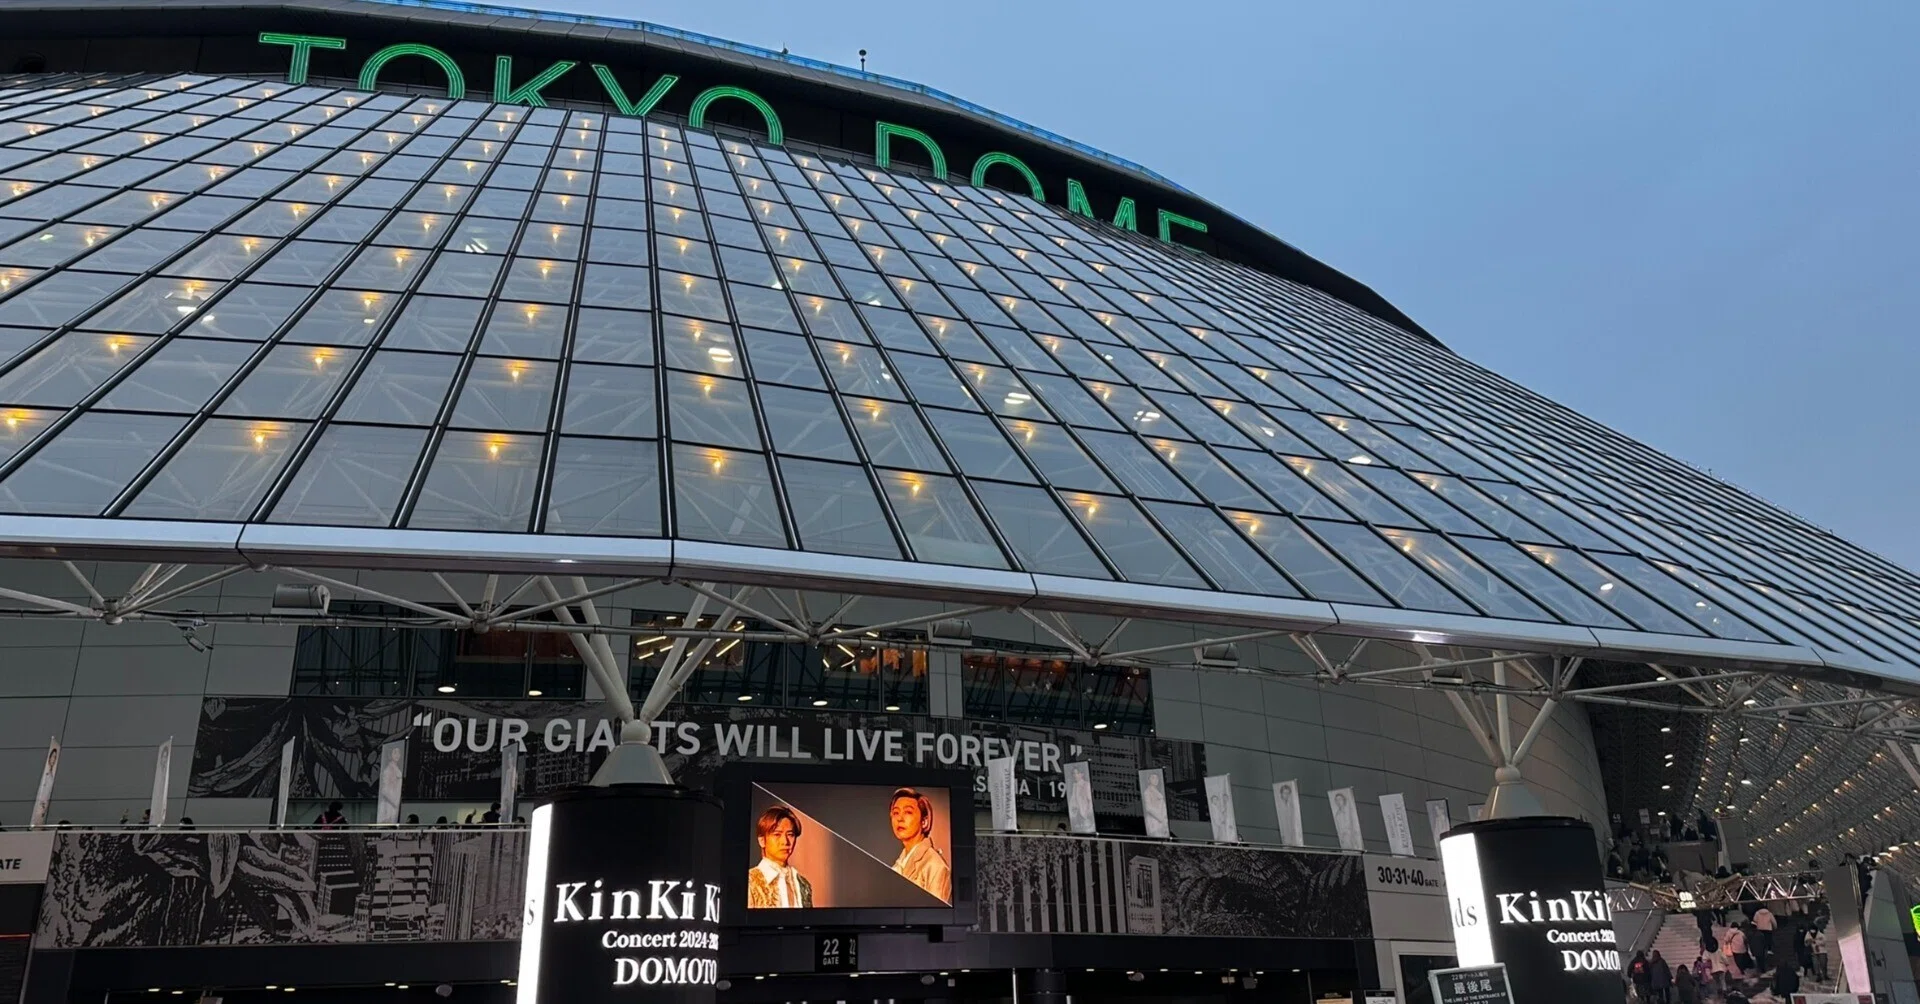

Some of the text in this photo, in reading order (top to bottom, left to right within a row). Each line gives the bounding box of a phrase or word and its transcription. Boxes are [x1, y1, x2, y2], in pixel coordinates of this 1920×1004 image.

[258, 32, 784, 146] TOKYO
[544, 718, 701, 755] GIATS
[714, 723, 811, 759] WILL
[824, 728, 904, 762] LIVE
[553, 880, 697, 923] KinKi
[602, 930, 677, 949] Concert
[1546, 929, 1600, 943] Concert
[823, 938, 839, 956] 22
[822, 956, 840, 966] GATE
[612, 957, 718, 985] DOMOTO
[1453, 979, 1492, 994] 最後尾
